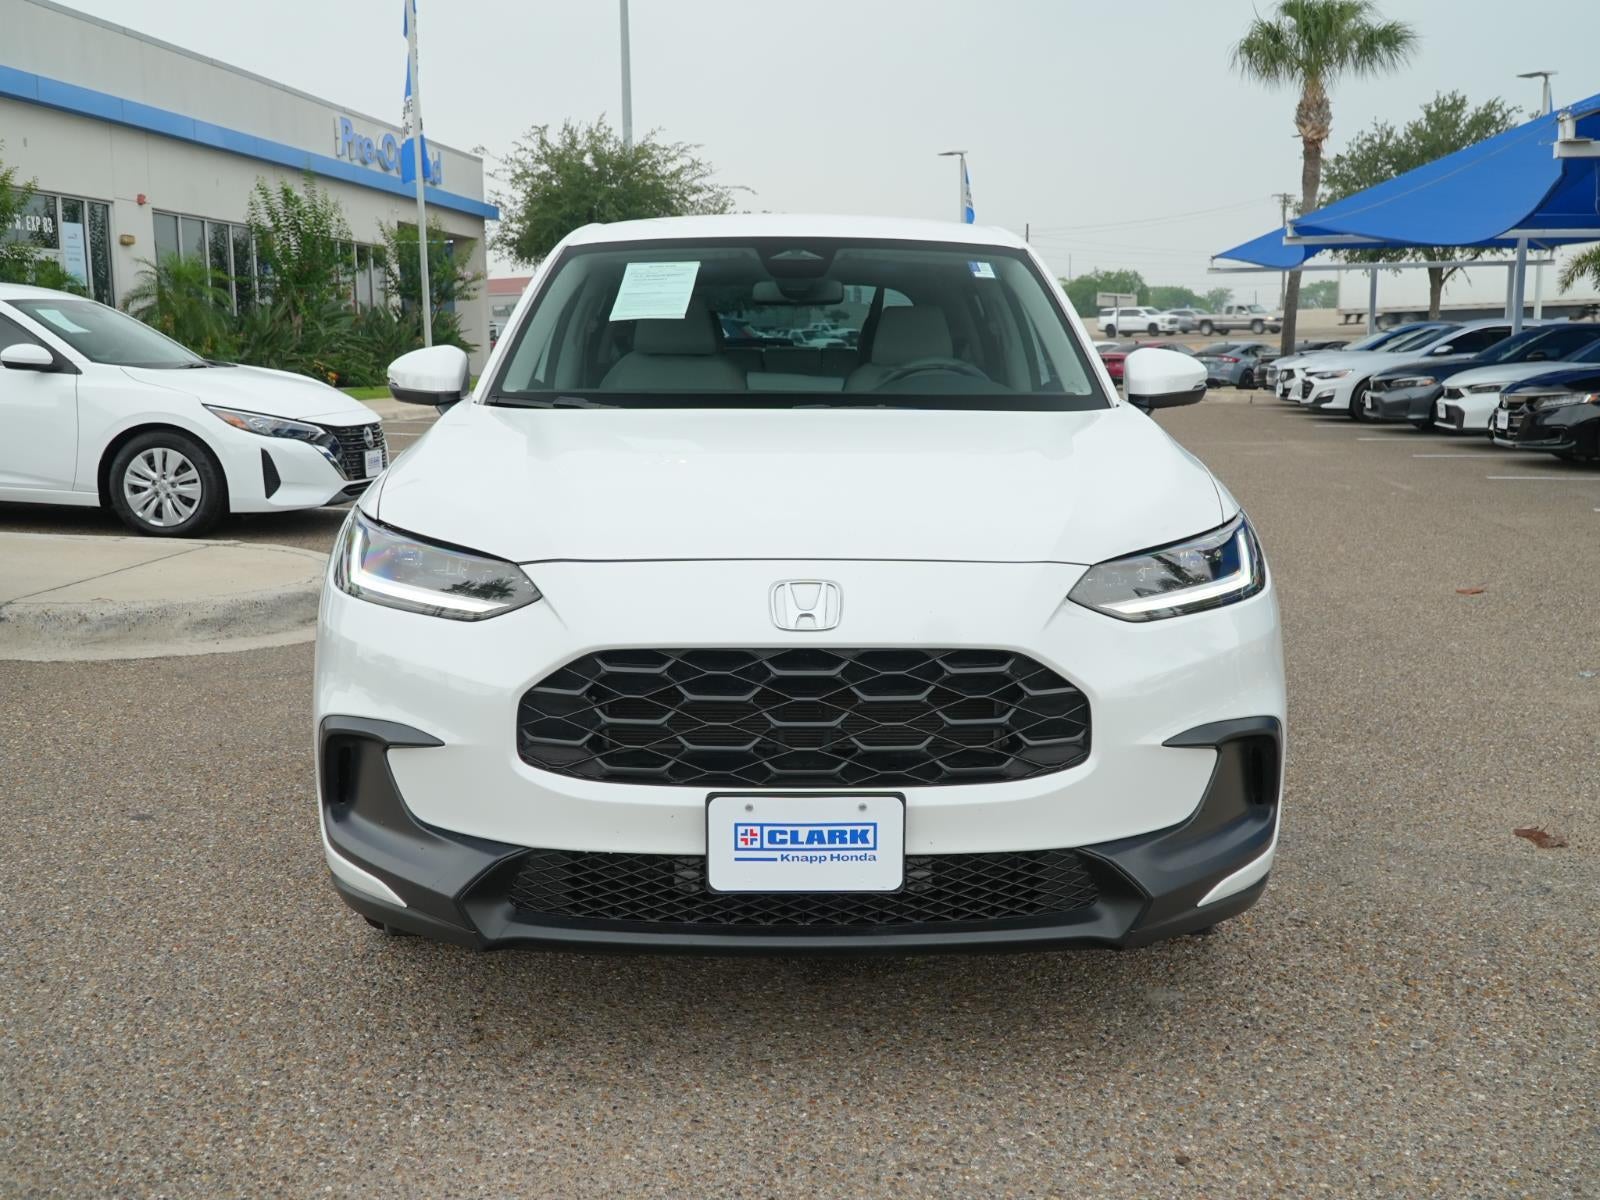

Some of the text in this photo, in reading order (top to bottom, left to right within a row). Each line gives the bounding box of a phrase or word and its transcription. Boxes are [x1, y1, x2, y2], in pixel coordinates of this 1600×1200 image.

[336, 116, 442, 185] Pre-Od
[26, 215, 41, 231] EXP
[42, 216, 54, 233] 83
[767, 829, 870, 845] CLARK
[780, 853, 876, 864] Knapp Honda
